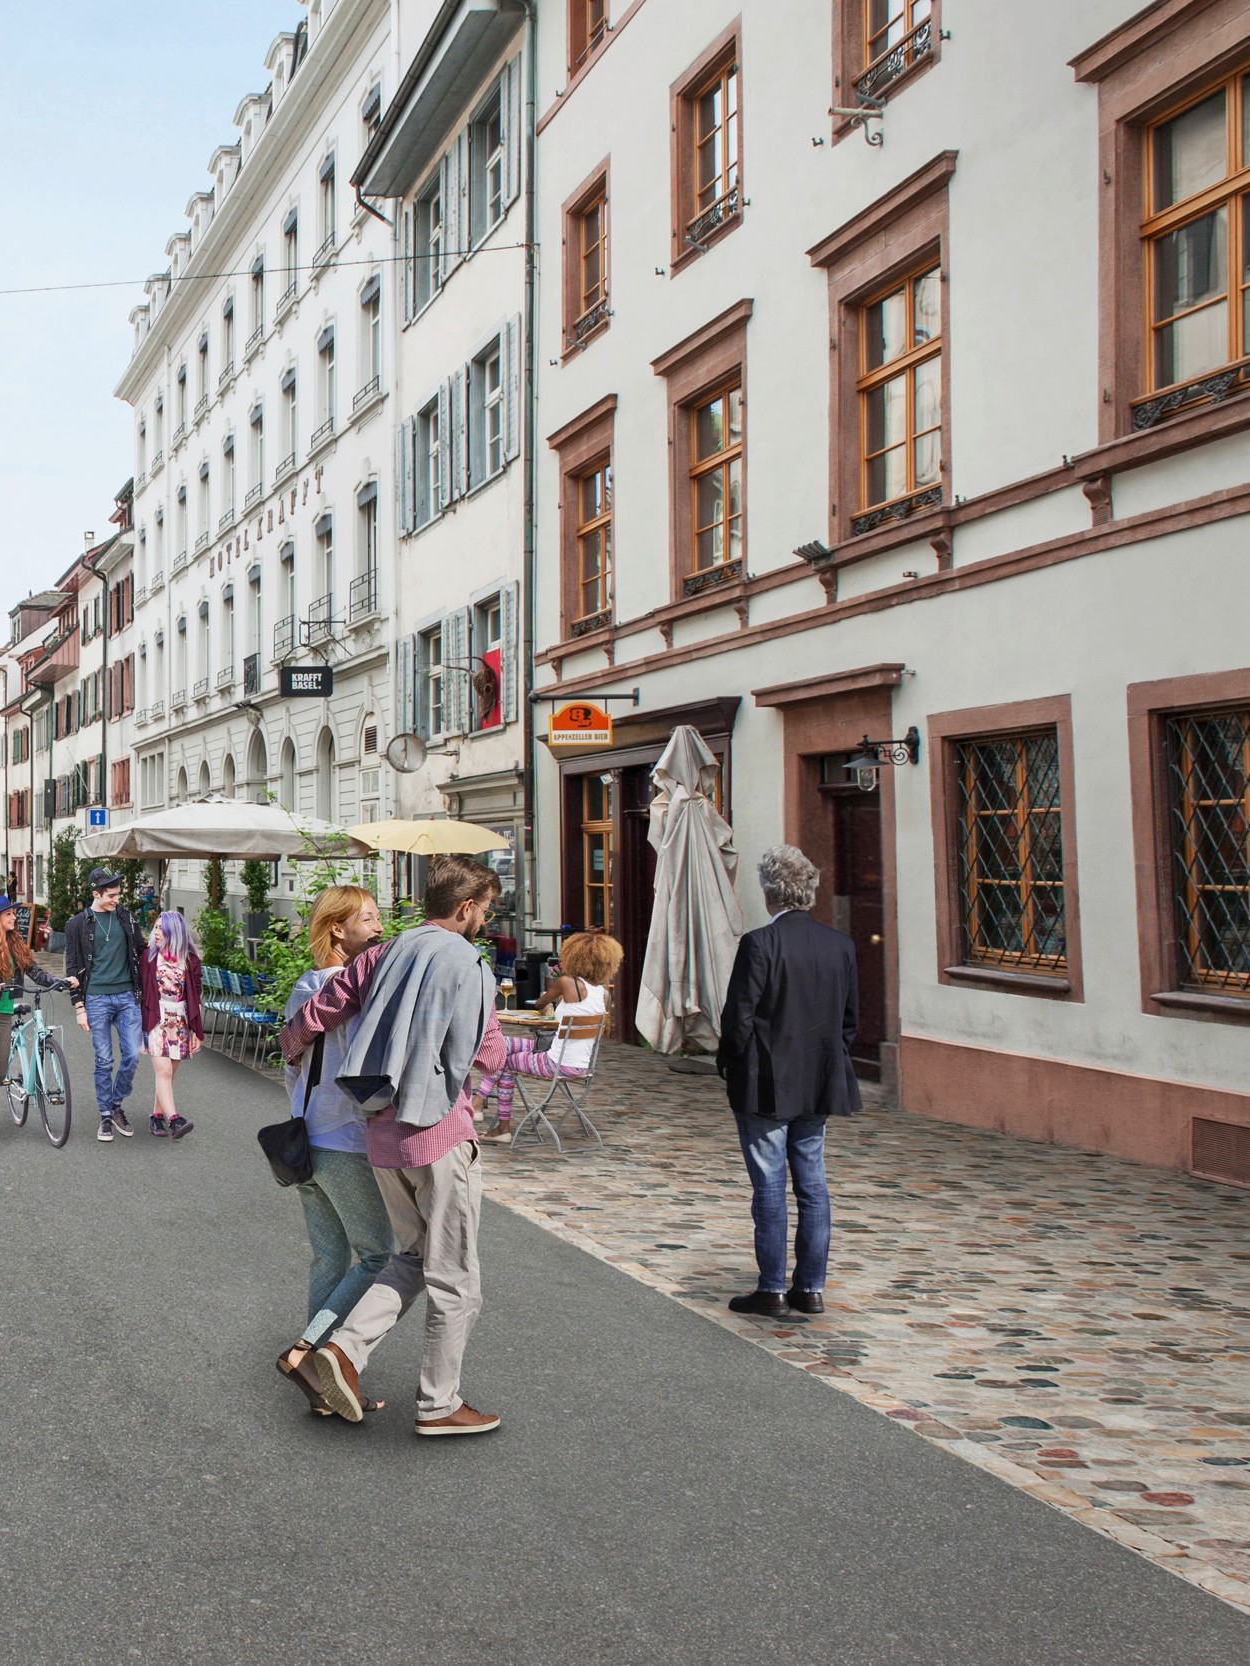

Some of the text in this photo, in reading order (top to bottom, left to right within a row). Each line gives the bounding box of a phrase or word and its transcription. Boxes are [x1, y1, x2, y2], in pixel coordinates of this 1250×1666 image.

[209, 465, 324, 577] HOTEL KRAFFT
[291, 673, 323, 682] KRAFFT
[291, 681, 322, 690] BASEL.
[553, 733, 593, 741] APPENZELLER
